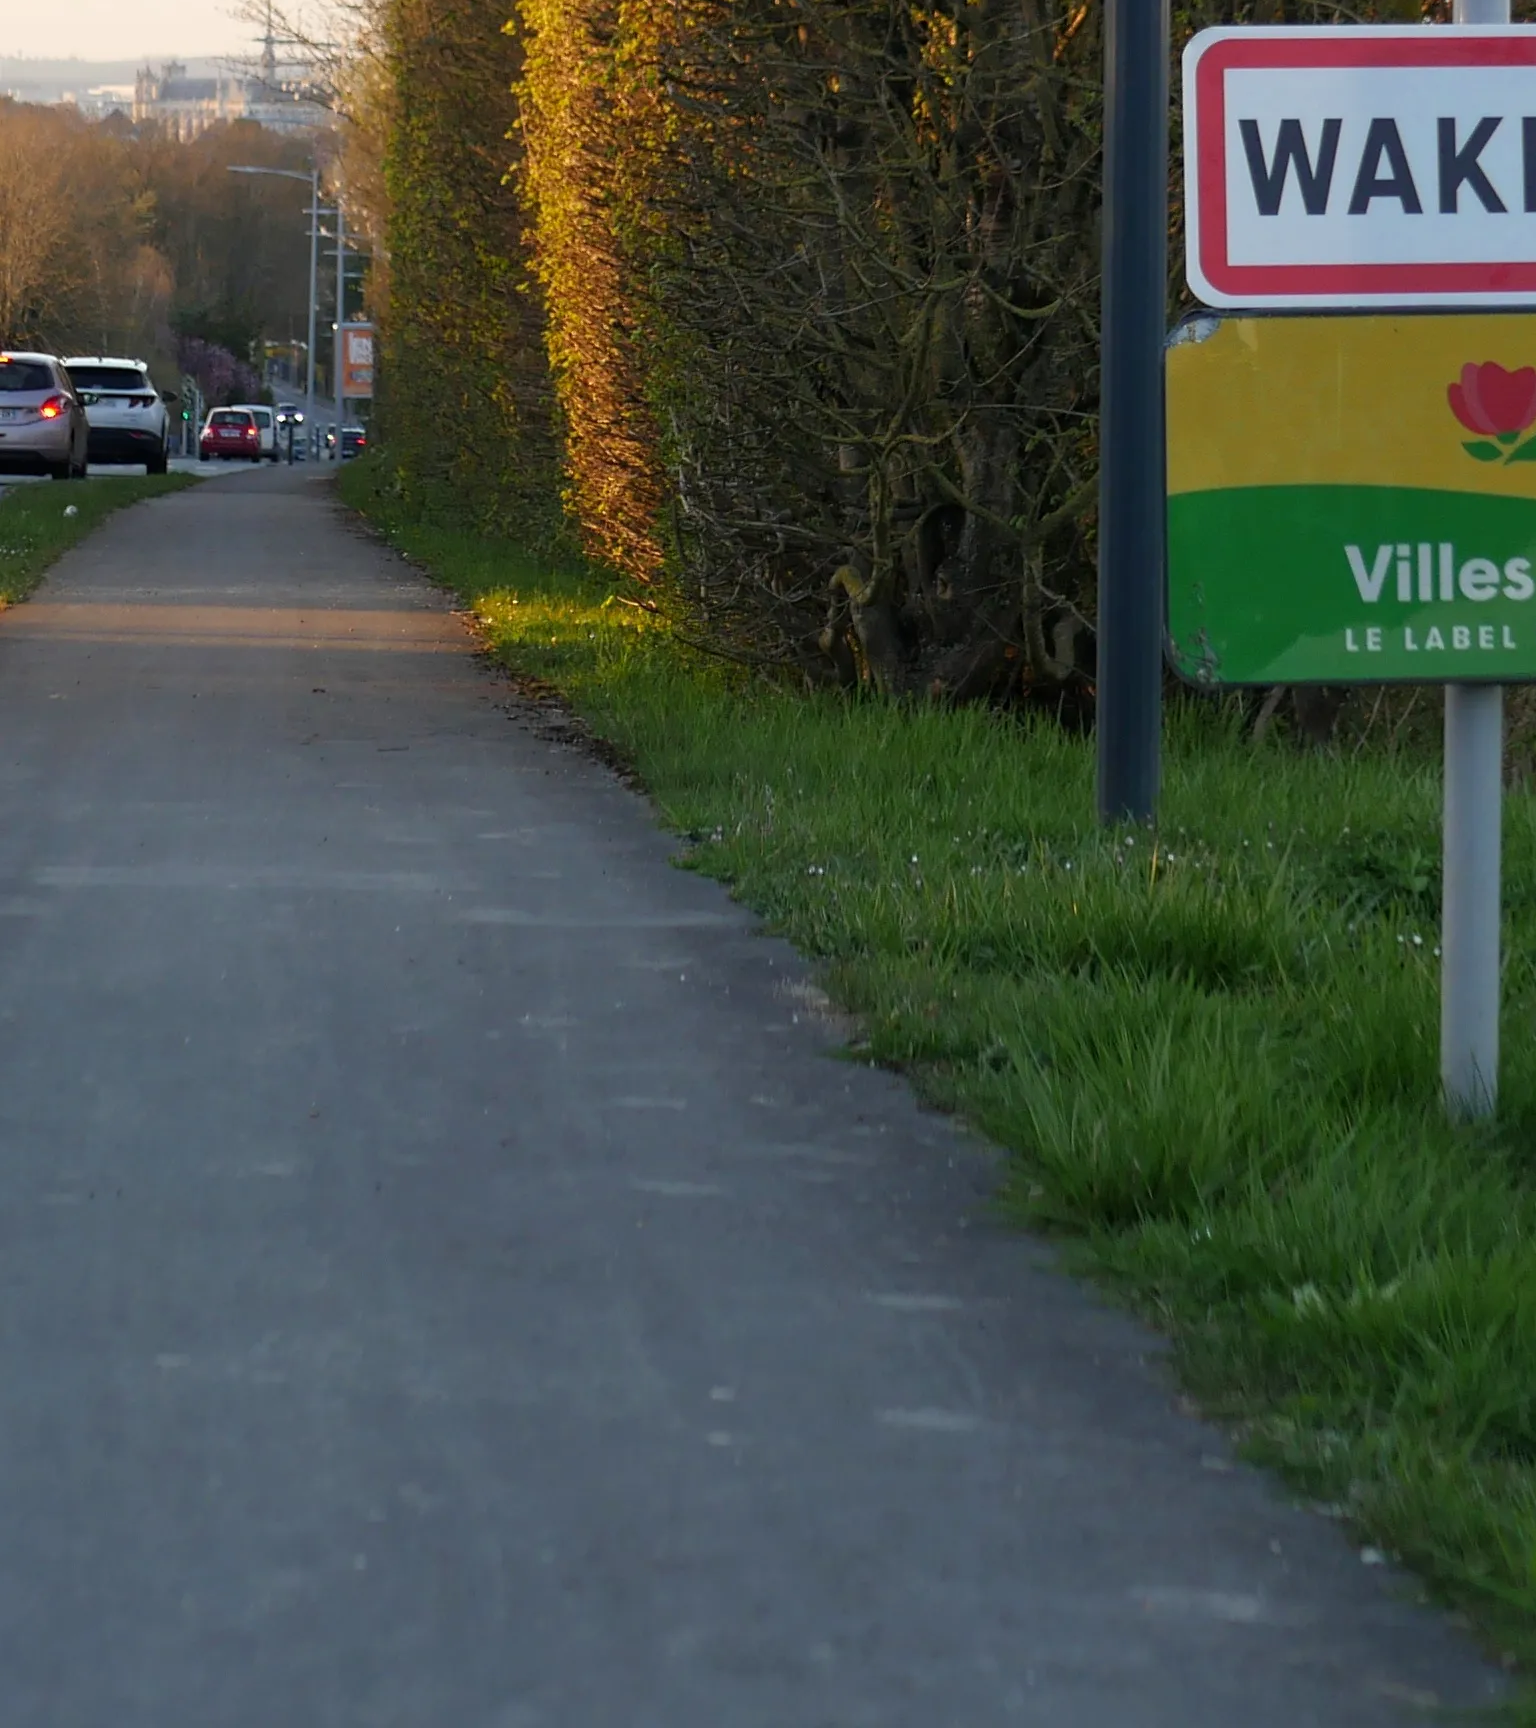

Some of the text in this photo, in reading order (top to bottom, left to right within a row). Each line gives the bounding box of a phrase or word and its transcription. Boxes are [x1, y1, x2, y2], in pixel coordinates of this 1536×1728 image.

[1344, 542, 1536, 603] Villes
[1345, 627, 1382, 652] LE
[1404, 625, 1516, 651] LABEL
